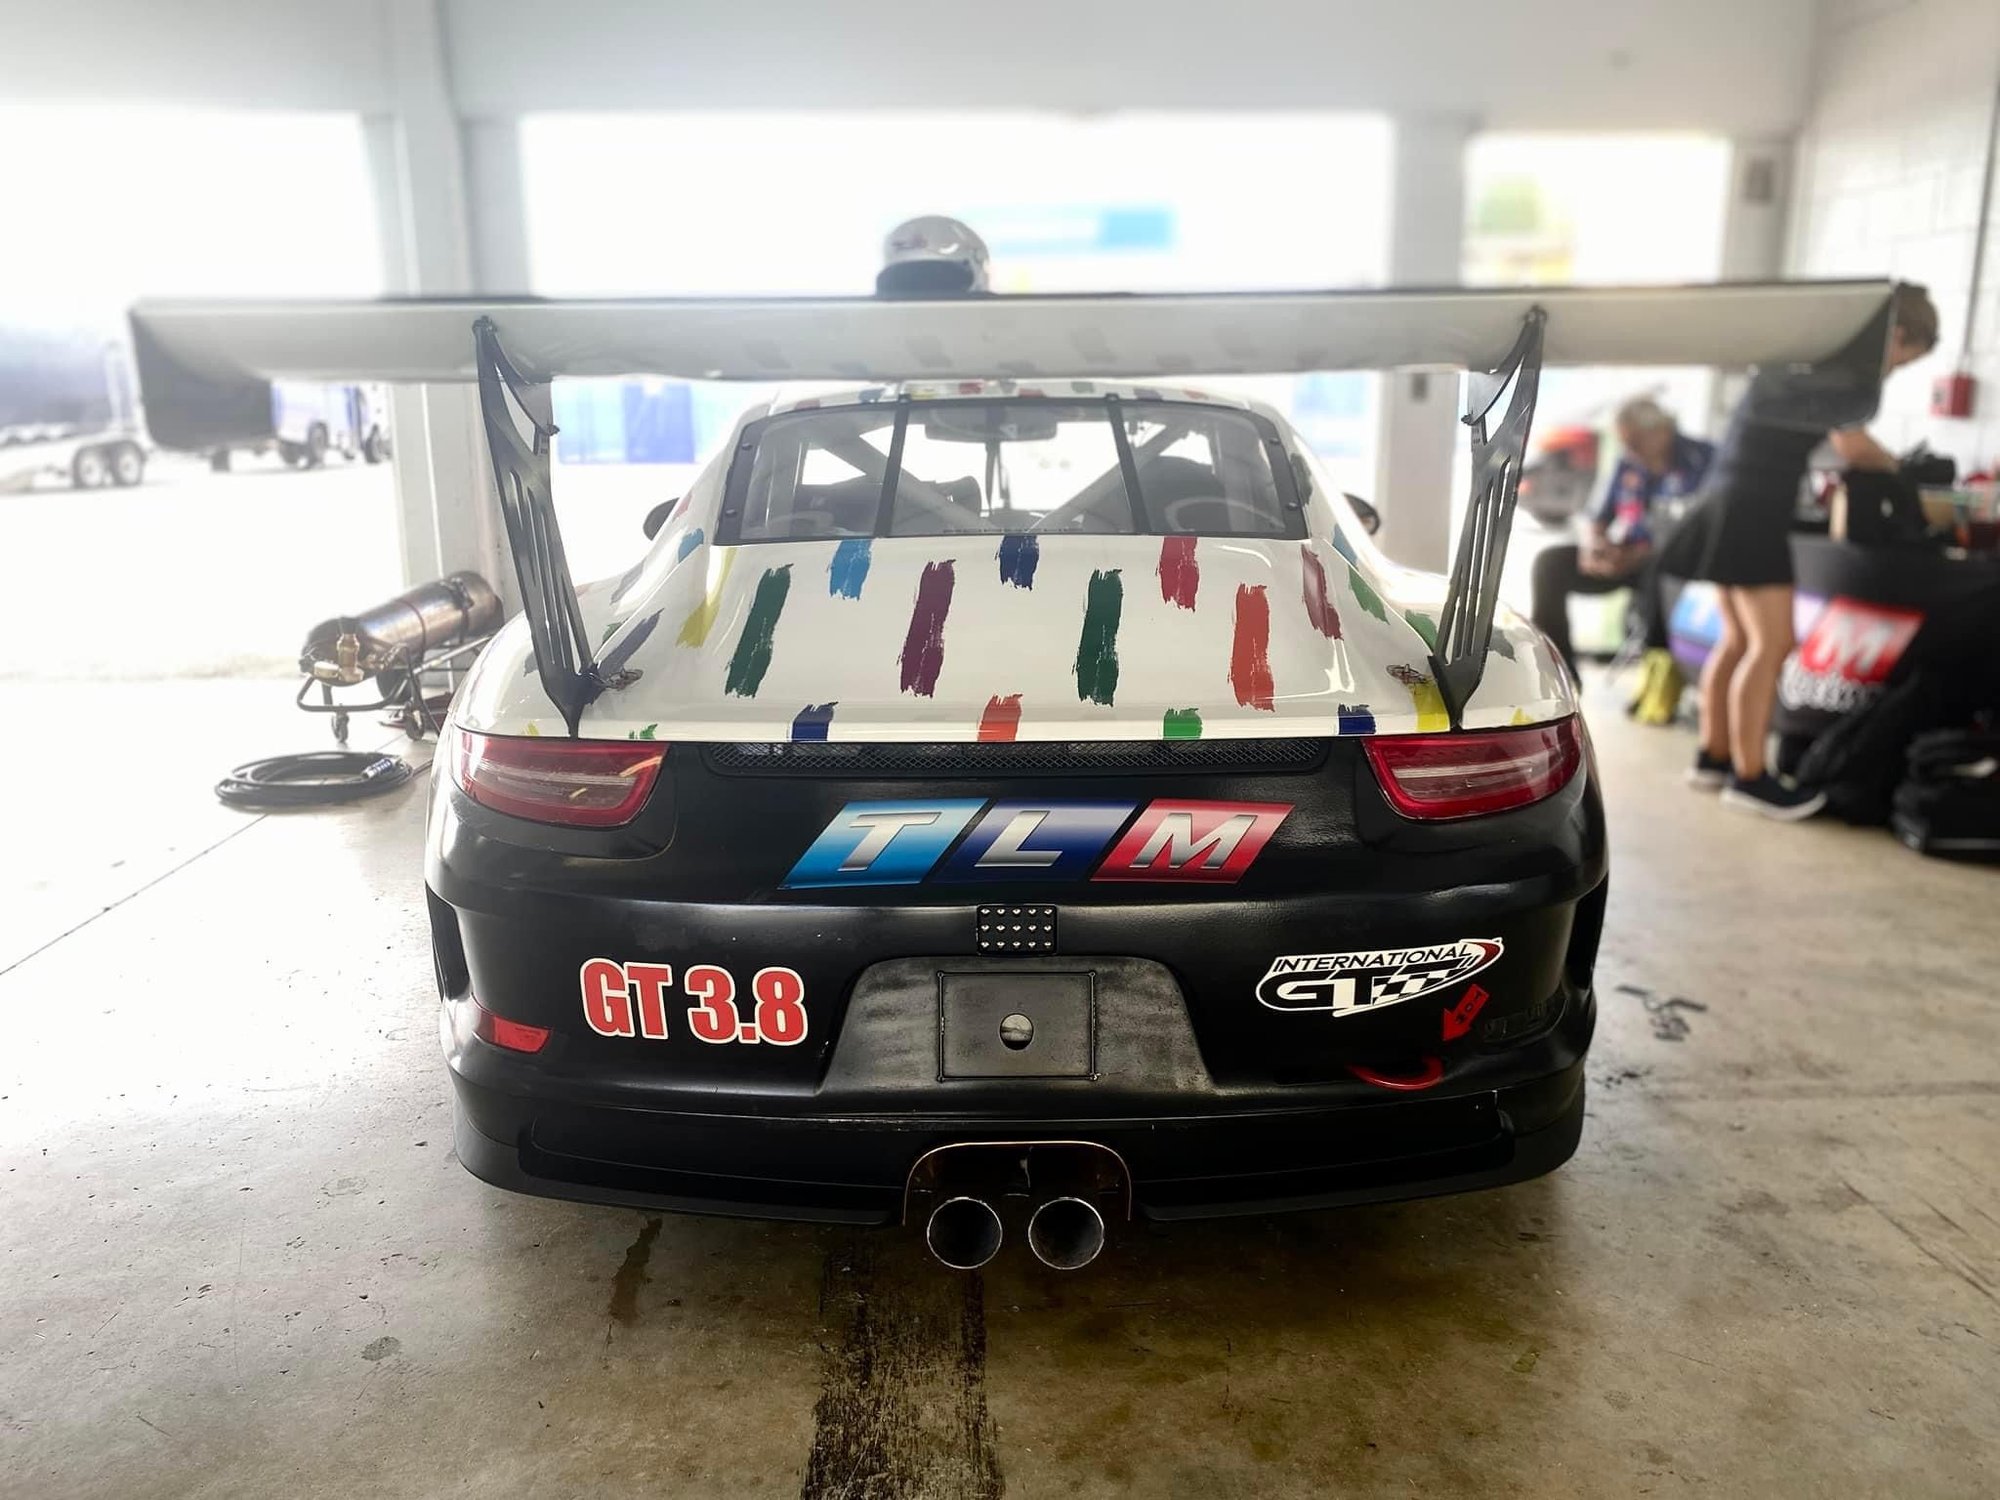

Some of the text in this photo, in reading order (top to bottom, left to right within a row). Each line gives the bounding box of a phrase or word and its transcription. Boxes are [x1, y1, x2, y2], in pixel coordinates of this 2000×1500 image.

[837, 810, 1257, 872] TLM
[1272, 944, 1472, 973] INTERNATIONAL
[581, 958, 808, 1045] GT 3.8
